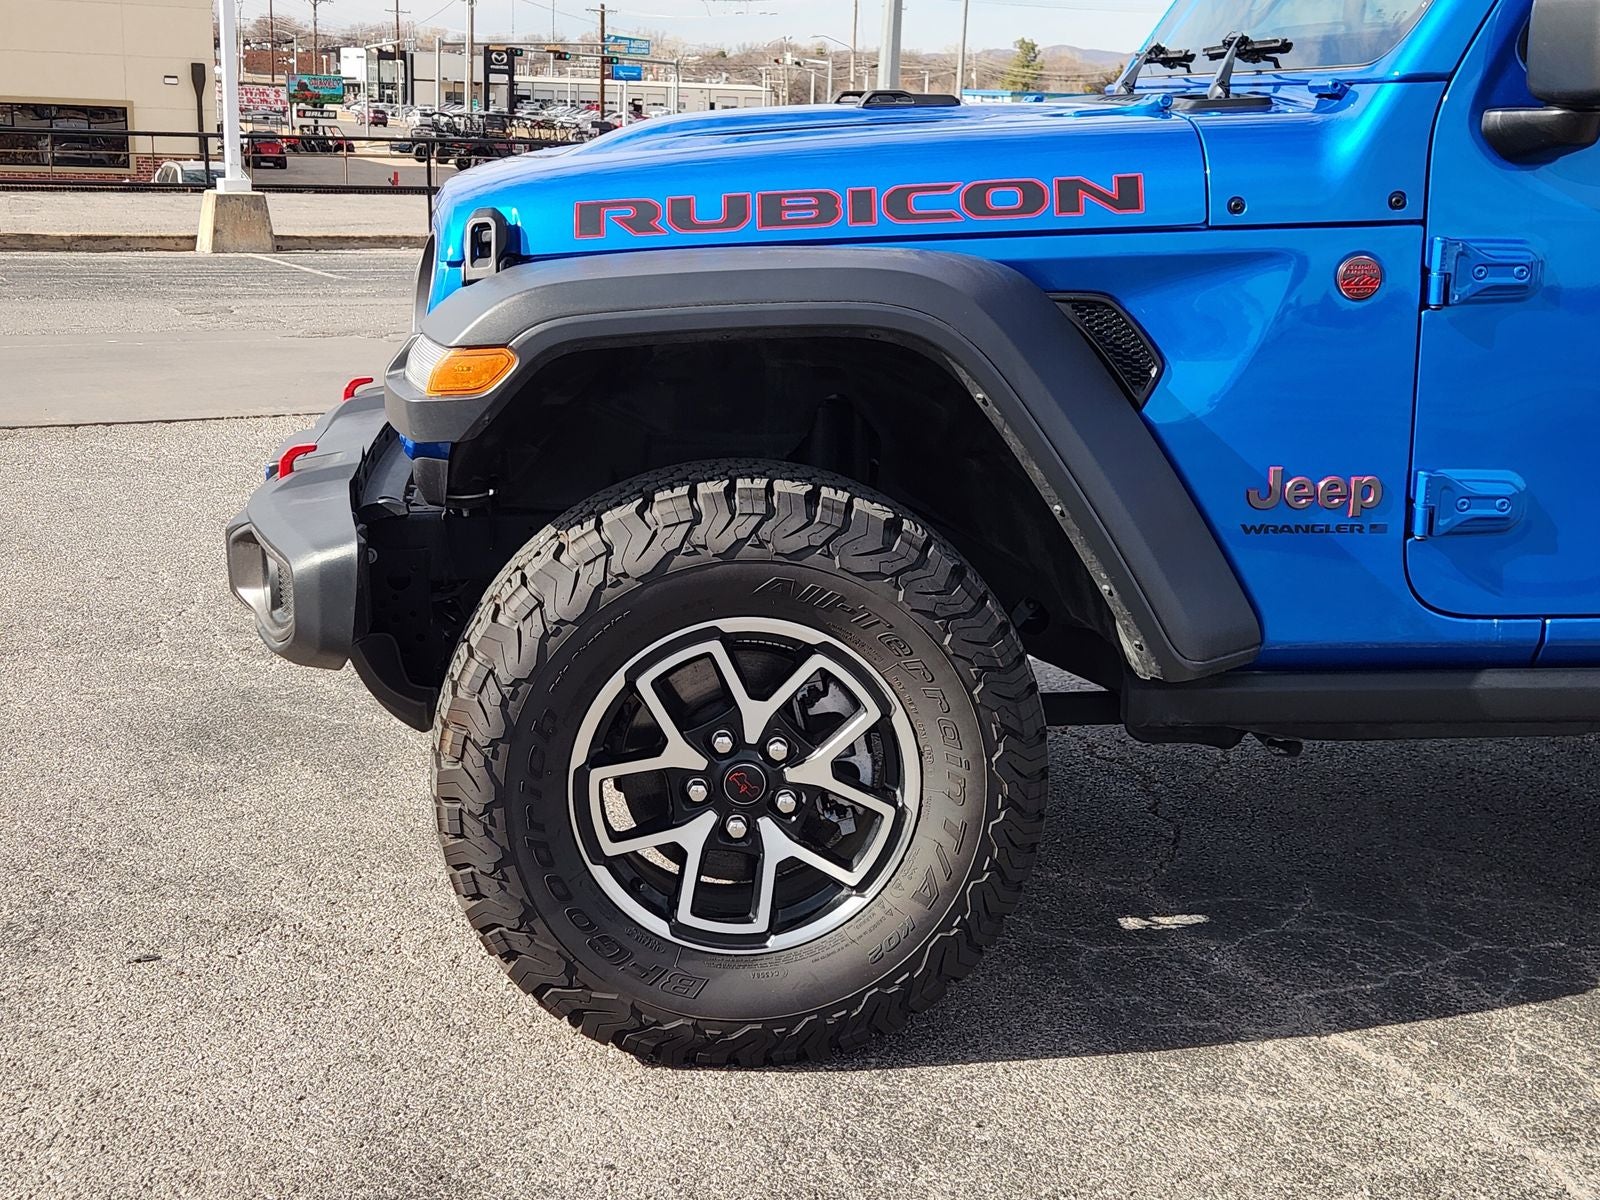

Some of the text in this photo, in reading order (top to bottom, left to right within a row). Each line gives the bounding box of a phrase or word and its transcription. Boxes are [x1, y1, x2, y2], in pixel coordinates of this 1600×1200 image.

[574, 172, 1145, 240] RUBICON
[1246, 465, 1383, 517] Jeep
[1240, 523, 1365, 535] WRANGLER
